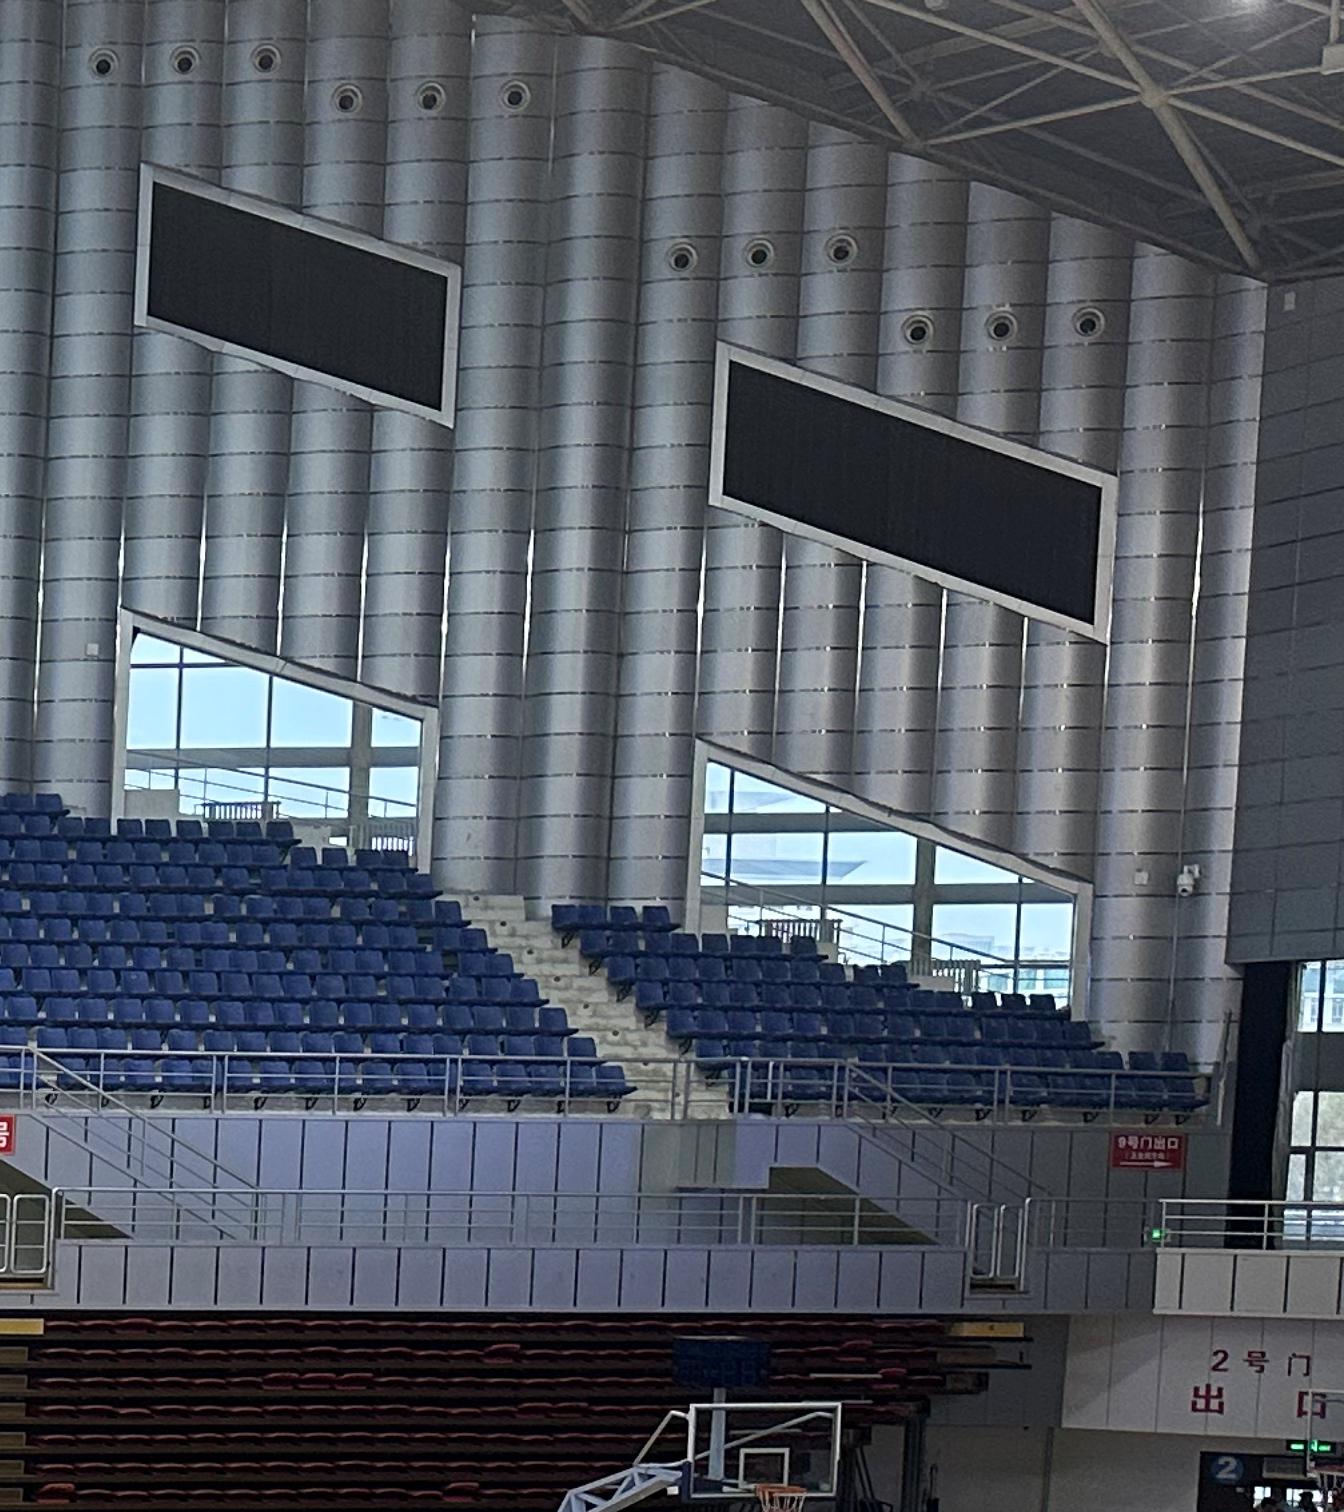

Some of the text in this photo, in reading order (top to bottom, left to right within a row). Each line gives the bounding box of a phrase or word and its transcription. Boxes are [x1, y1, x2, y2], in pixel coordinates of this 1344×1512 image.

[1118, 1135, 1179, 1150] 9号门出口
[1215, 1456, 1239, 1480] 2
